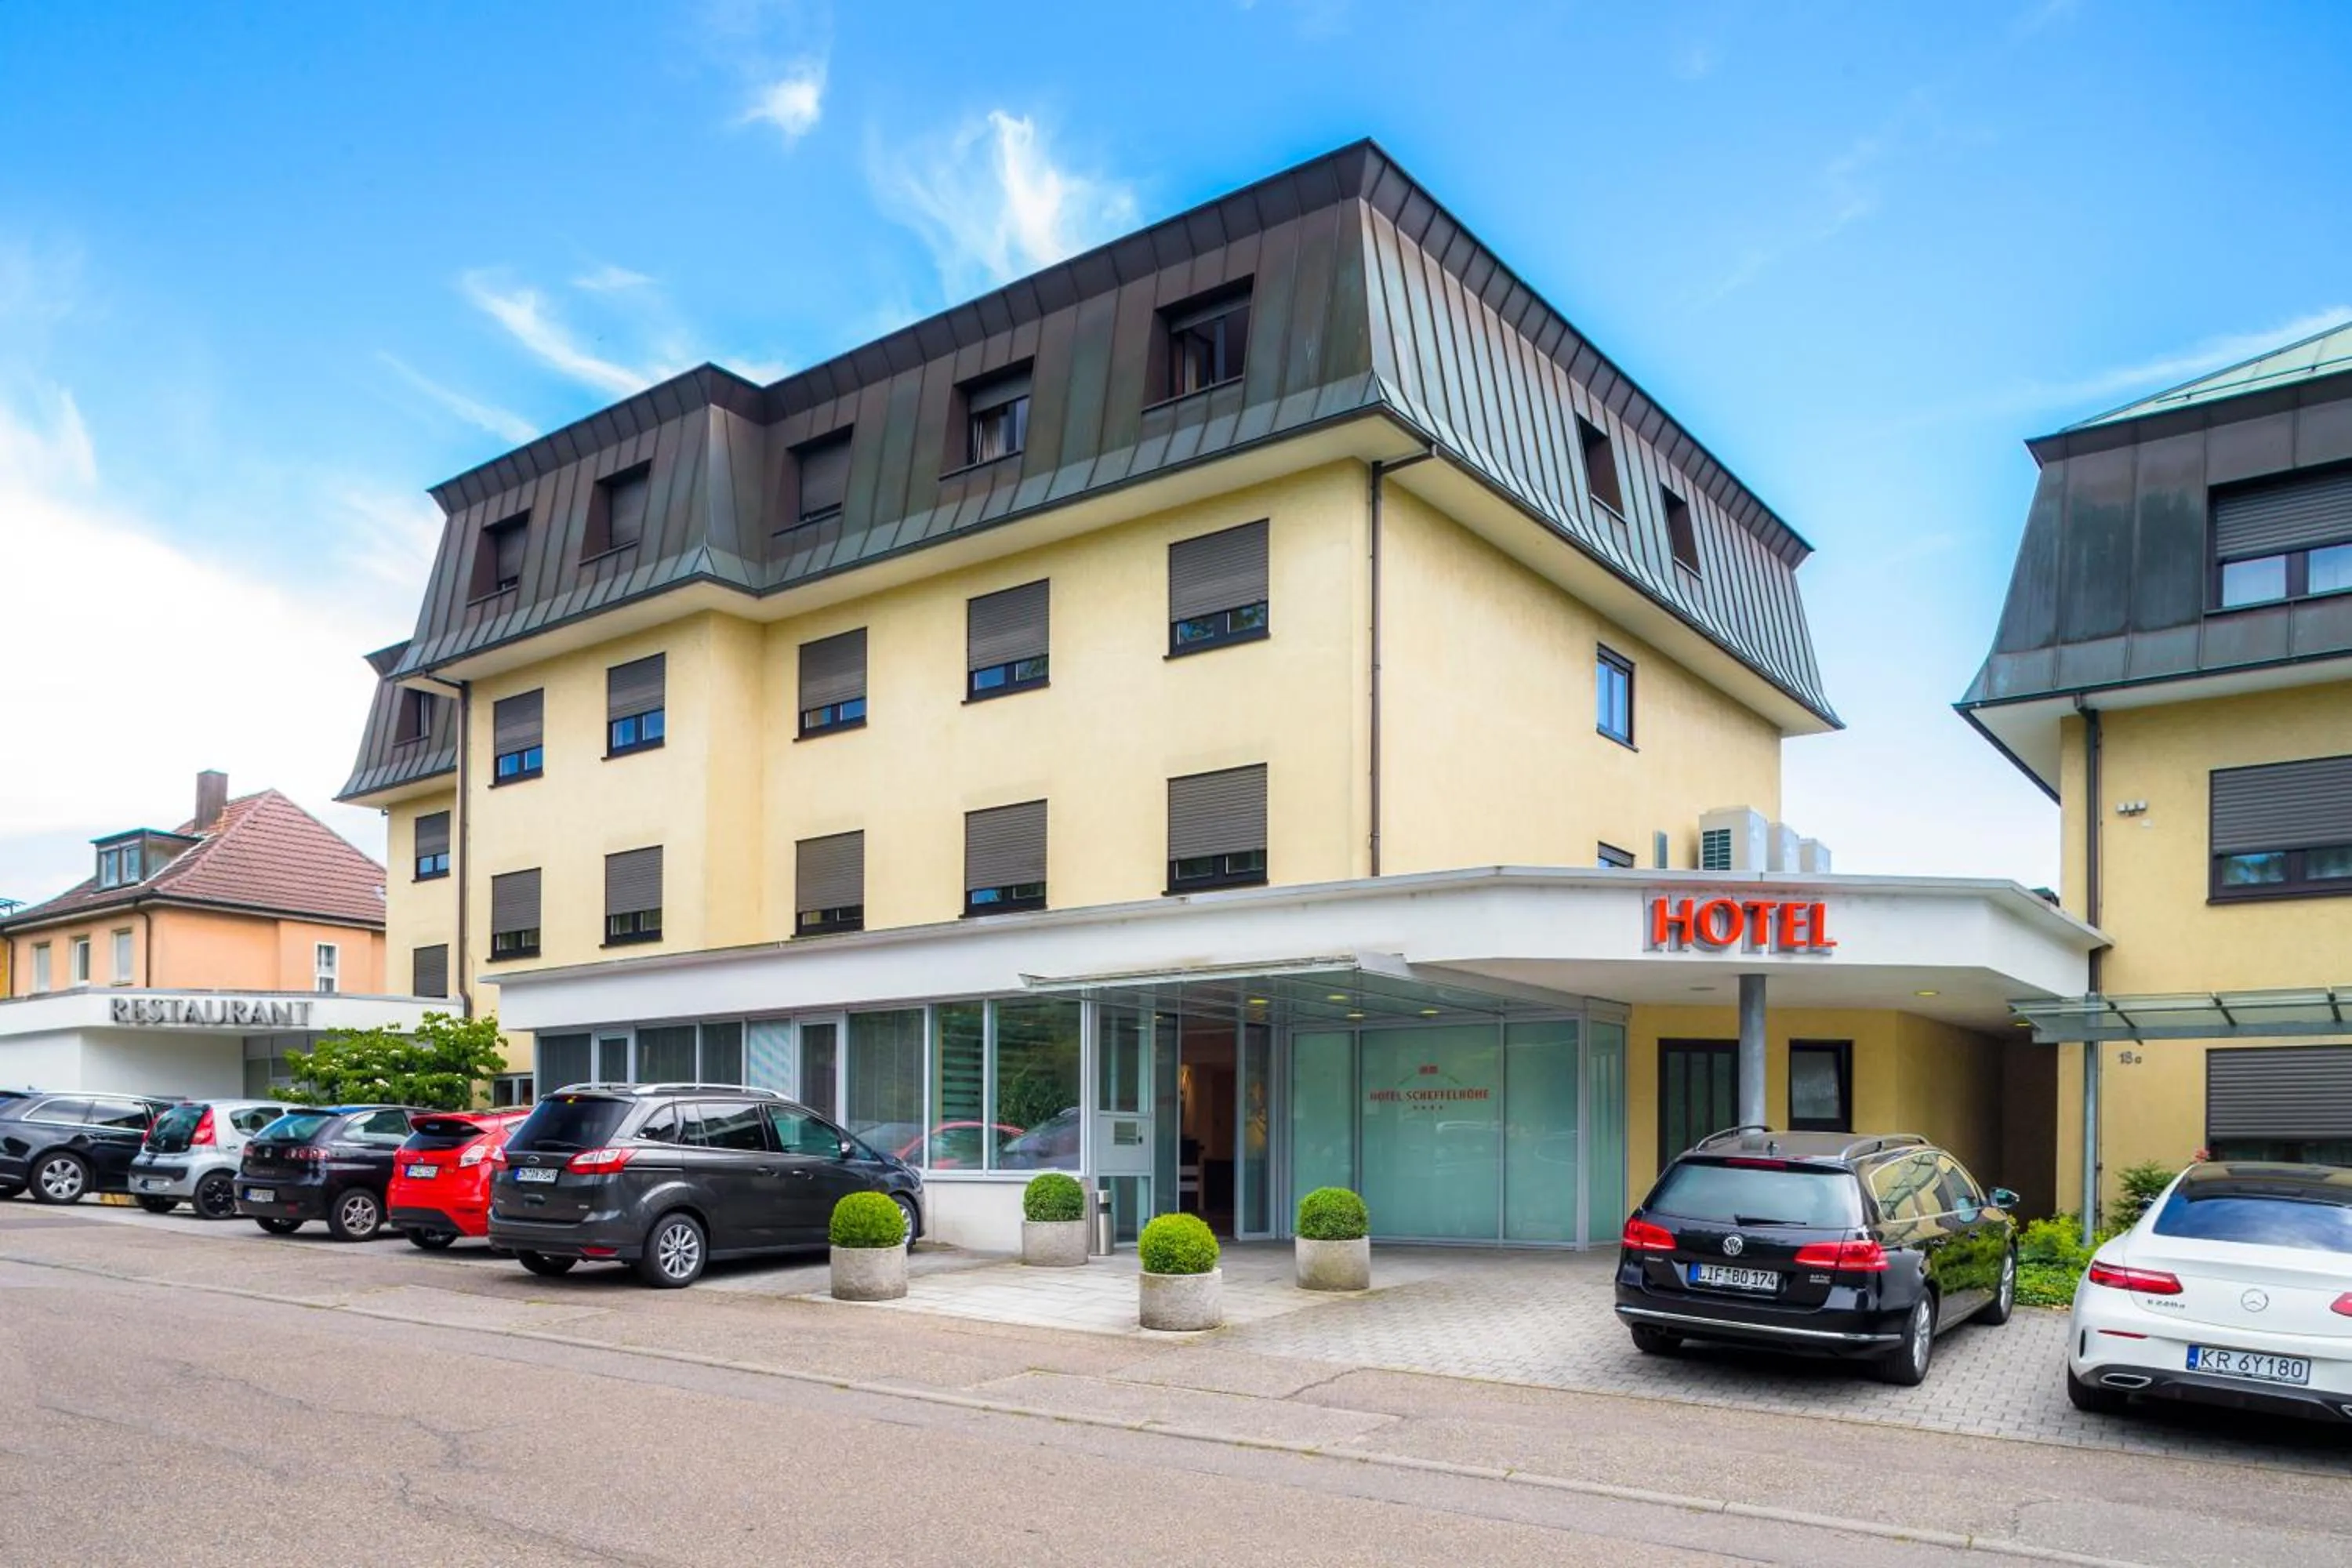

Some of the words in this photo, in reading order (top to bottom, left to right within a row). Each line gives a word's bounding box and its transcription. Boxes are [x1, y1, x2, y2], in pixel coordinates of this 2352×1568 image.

[1648, 895, 1838, 951] HOTEL
[110, 997, 314, 1026] RESTAURANT
[1370, 1091, 1402, 1102] HOTEL
[1698, 1265, 1724, 1281] LIF
[2200, 1348, 2231, 1369] KR
[2238, 1354, 2303, 1378] 6Y180
